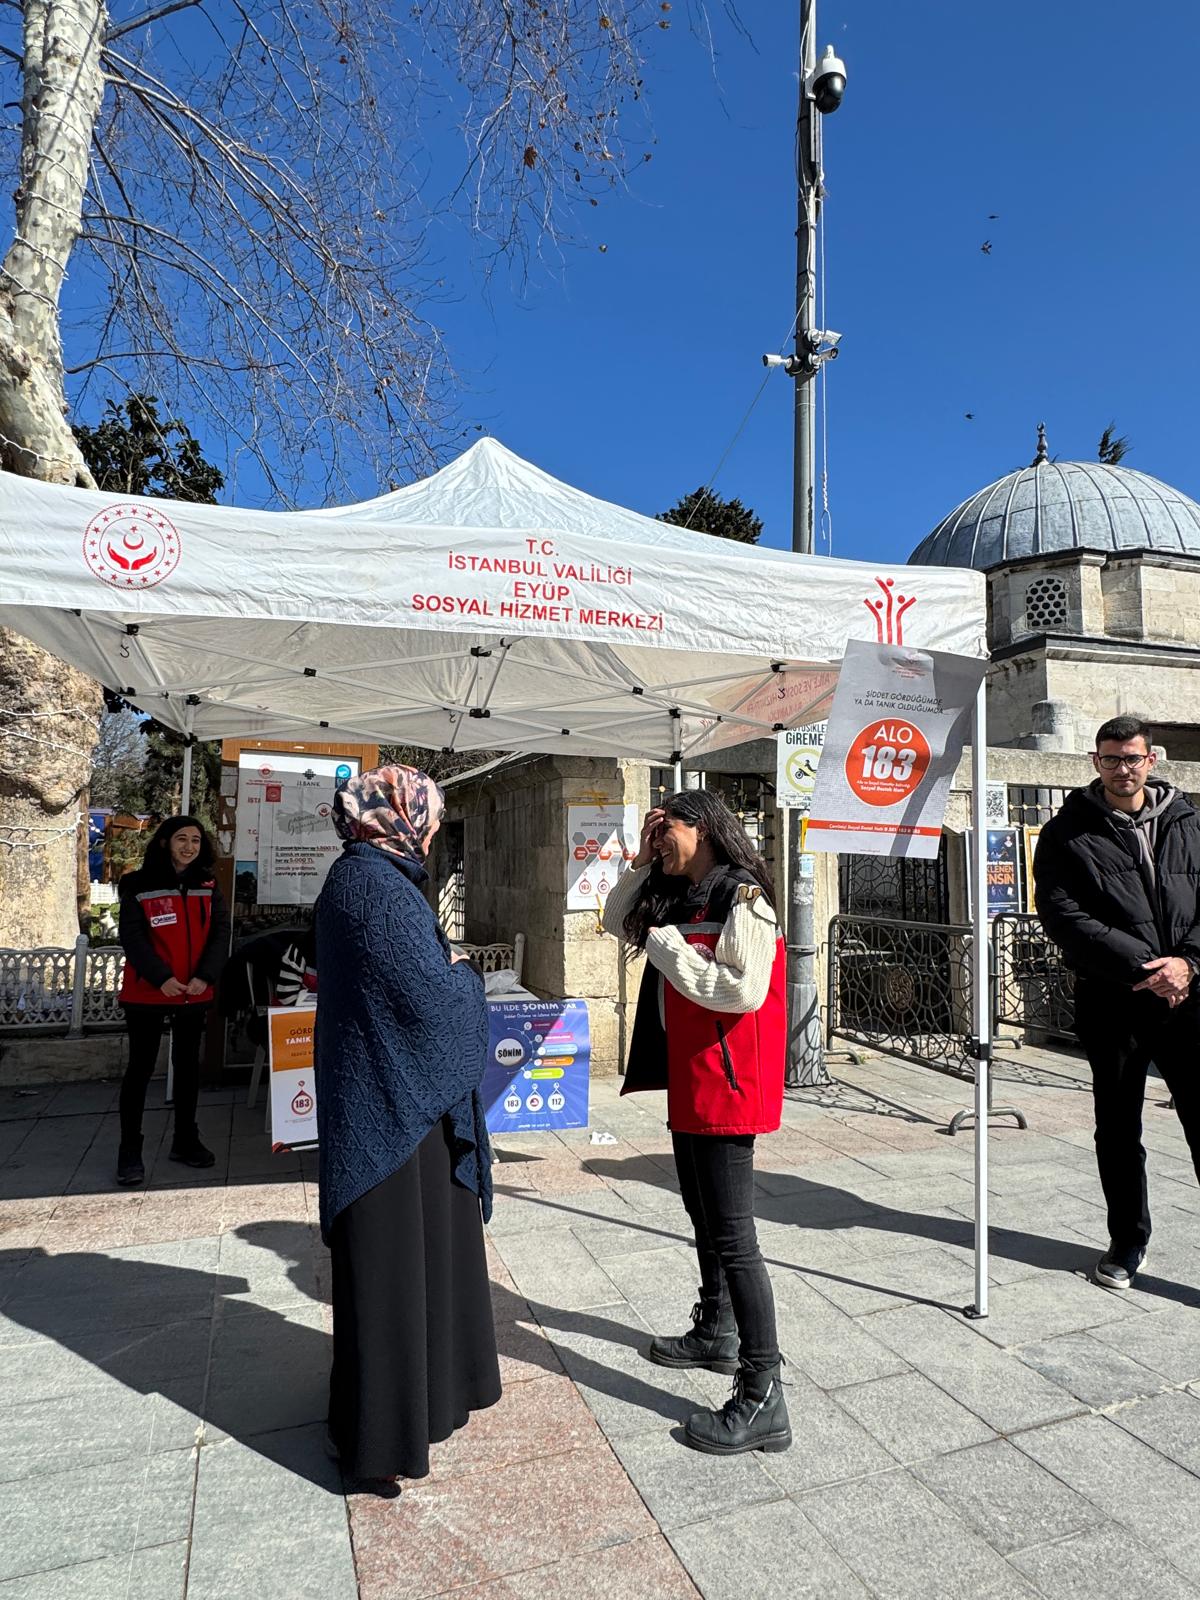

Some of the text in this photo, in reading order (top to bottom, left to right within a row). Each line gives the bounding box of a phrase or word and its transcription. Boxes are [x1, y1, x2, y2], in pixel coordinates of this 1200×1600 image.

[526, 538, 559, 556] T.C.
[448, 551, 632, 585] İSTANBUL VALİLİĞİ
[514, 581, 570, 601] EYÜP
[412, 594, 663, 631] SOSYAL HİZMET MERKEZİ
[865, 690, 943, 705] ŞİDDET GÖRDÜĞÜMDE
[876, 701, 895, 709] TANIK
[897, 702, 944, 714] OLDUĞUMDA
[786, 732, 824, 746] GİREME
[874, 725, 912, 744] ALO
[862, 745, 917, 781] 183
[290, 1027, 312, 1036] GÖRD
[286, 1036, 311, 1045] TANIK
[497, 1048, 522, 1058] ŞÖNİM
[295, 1099, 310, 1109] 183
